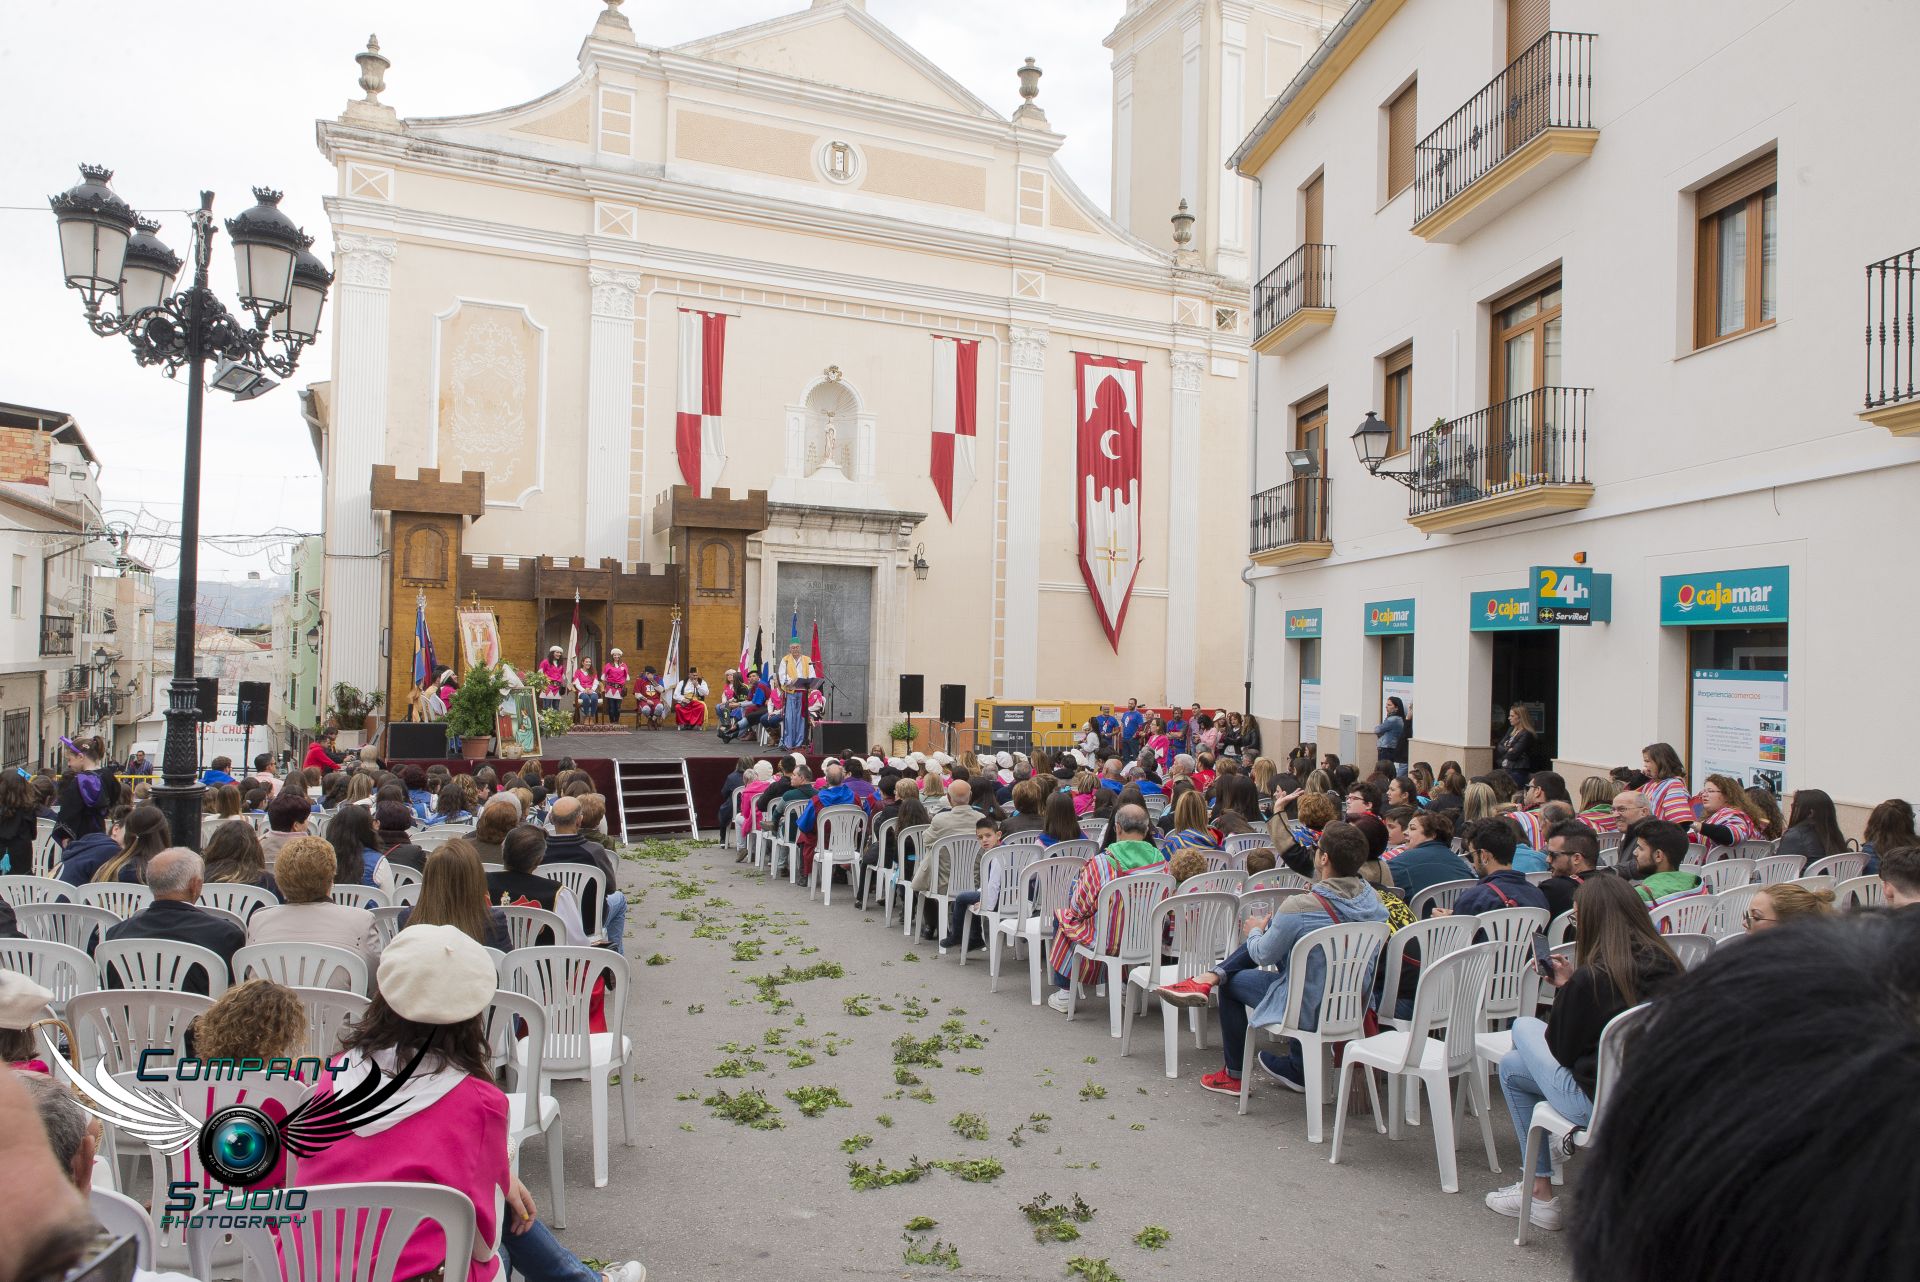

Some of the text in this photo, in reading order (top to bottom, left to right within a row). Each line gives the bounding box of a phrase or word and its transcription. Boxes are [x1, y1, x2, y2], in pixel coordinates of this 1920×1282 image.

[1540, 569, 1588, 605] 24h
[1696, 582, 1773, 612] cajamar
[1379, 607, 1410, 626] cajamar
[1498, 597, 1530, 620] cajam
[1555, 612, 1589, 621] ServiRed
[1731, 604, 1770, 613] CAJA RURAL
